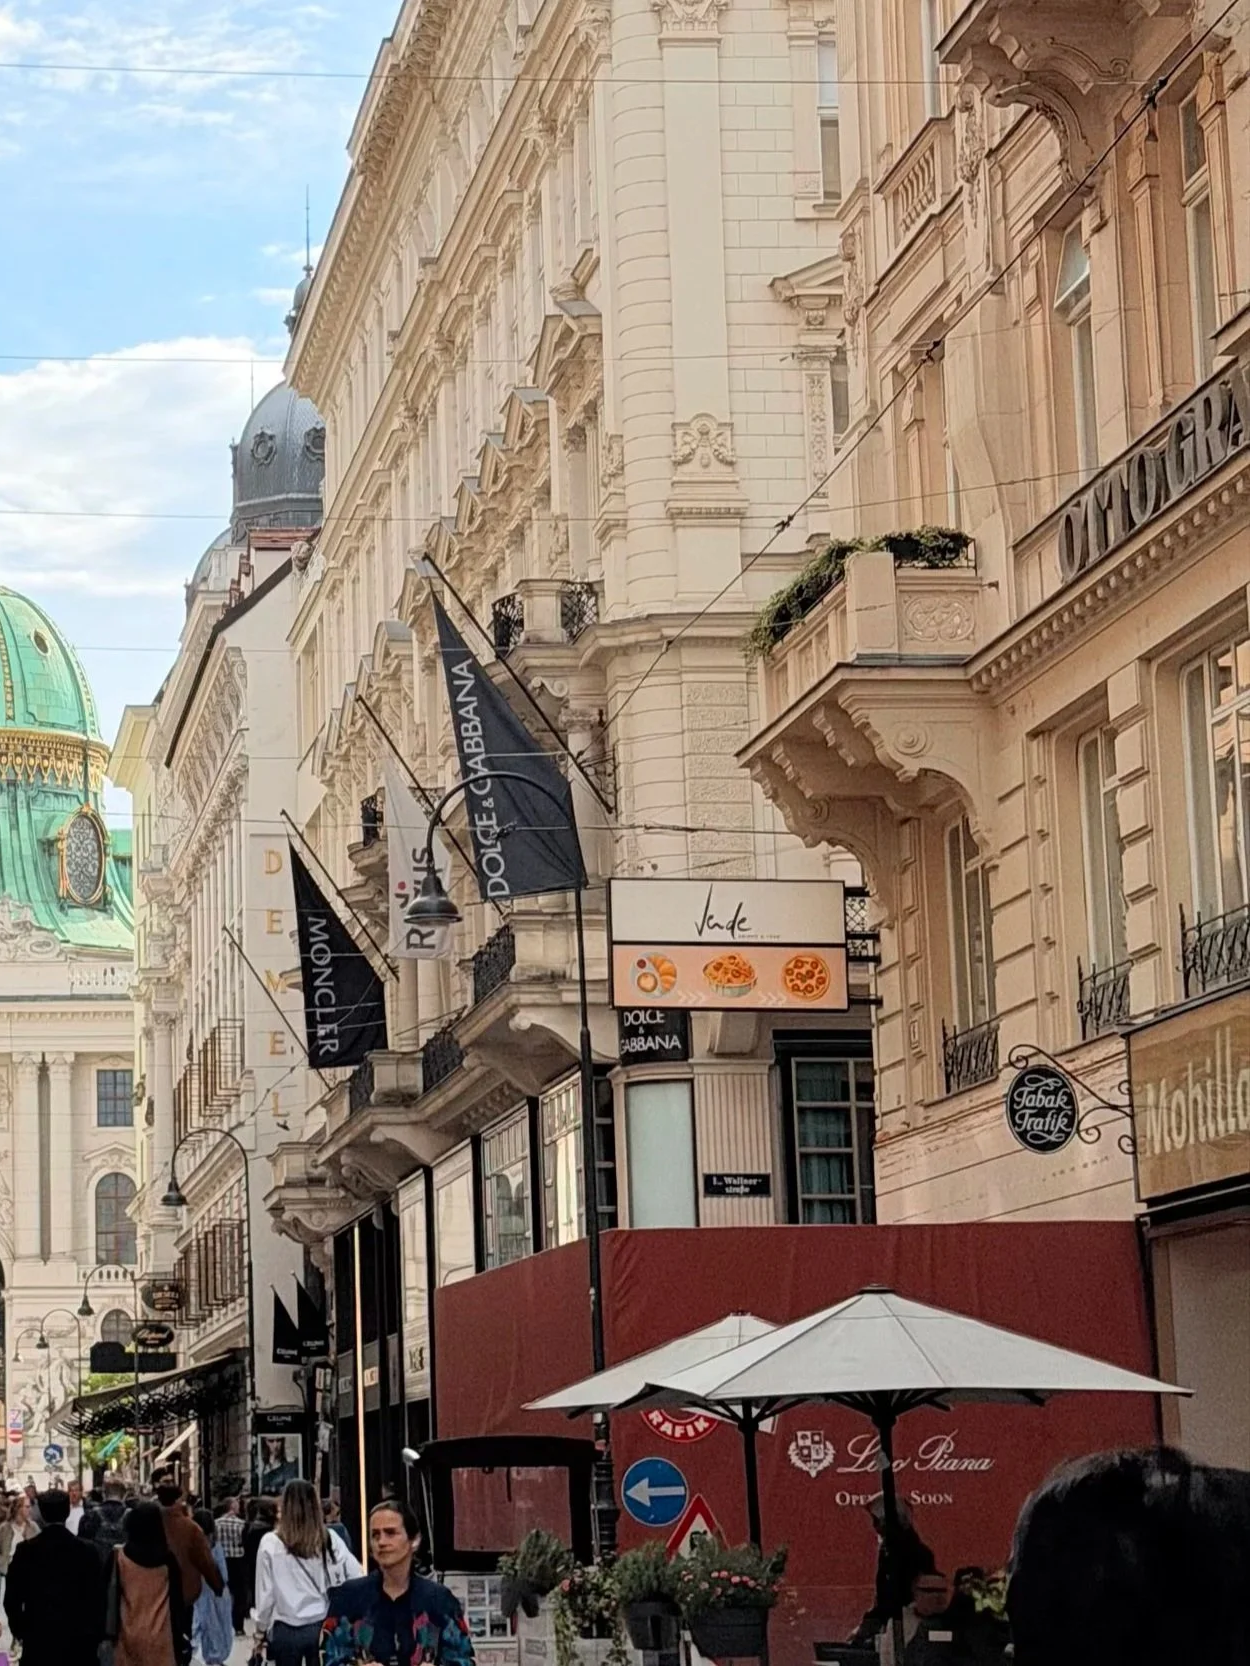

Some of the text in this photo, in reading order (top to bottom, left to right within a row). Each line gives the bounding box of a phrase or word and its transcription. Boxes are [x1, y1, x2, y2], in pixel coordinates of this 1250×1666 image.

[451, 658, 510, 897] DOLCE & GABBANA
[307, 915, 340, 1056] MONCLER
[622, 1009, 665, 1024] DOLCE
[620, 1034, 682, 1055] GABBANA
[1013, 1078, 1073, 1110] Tabak
[1014, 1109, 1073, 1140] Trafik
[648, 1409, 710, 1438] RAFIK
[913, 1429, 995, 1472] Piana
